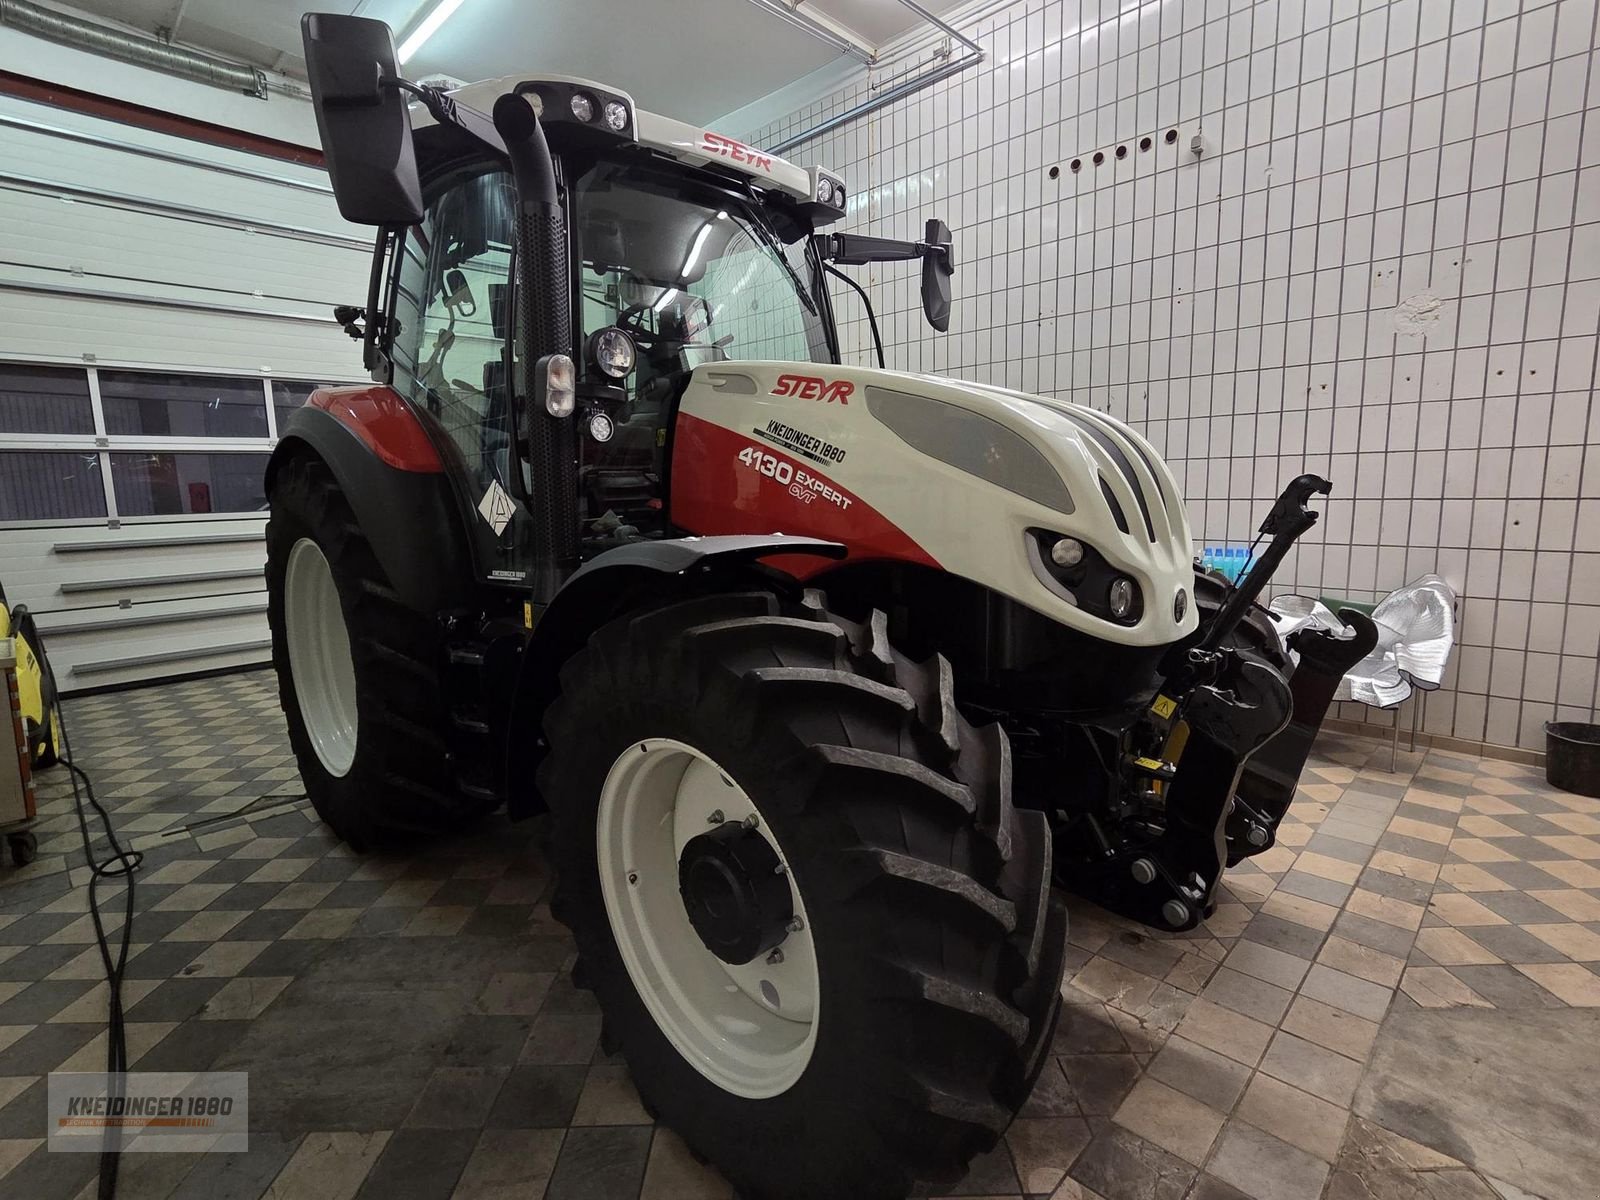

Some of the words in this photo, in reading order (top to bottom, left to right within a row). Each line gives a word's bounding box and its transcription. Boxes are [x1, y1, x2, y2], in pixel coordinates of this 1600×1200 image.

[703, 132, 771, 172] STEYR
[772, 374, 855, 405] STEYR
[766, 419, 821, 451] KNEIDINGER
[821, 444, 846, 463] 1880
[738, 447, 793, 486] 4130
[795, 470, 853, 510] EXPERT
